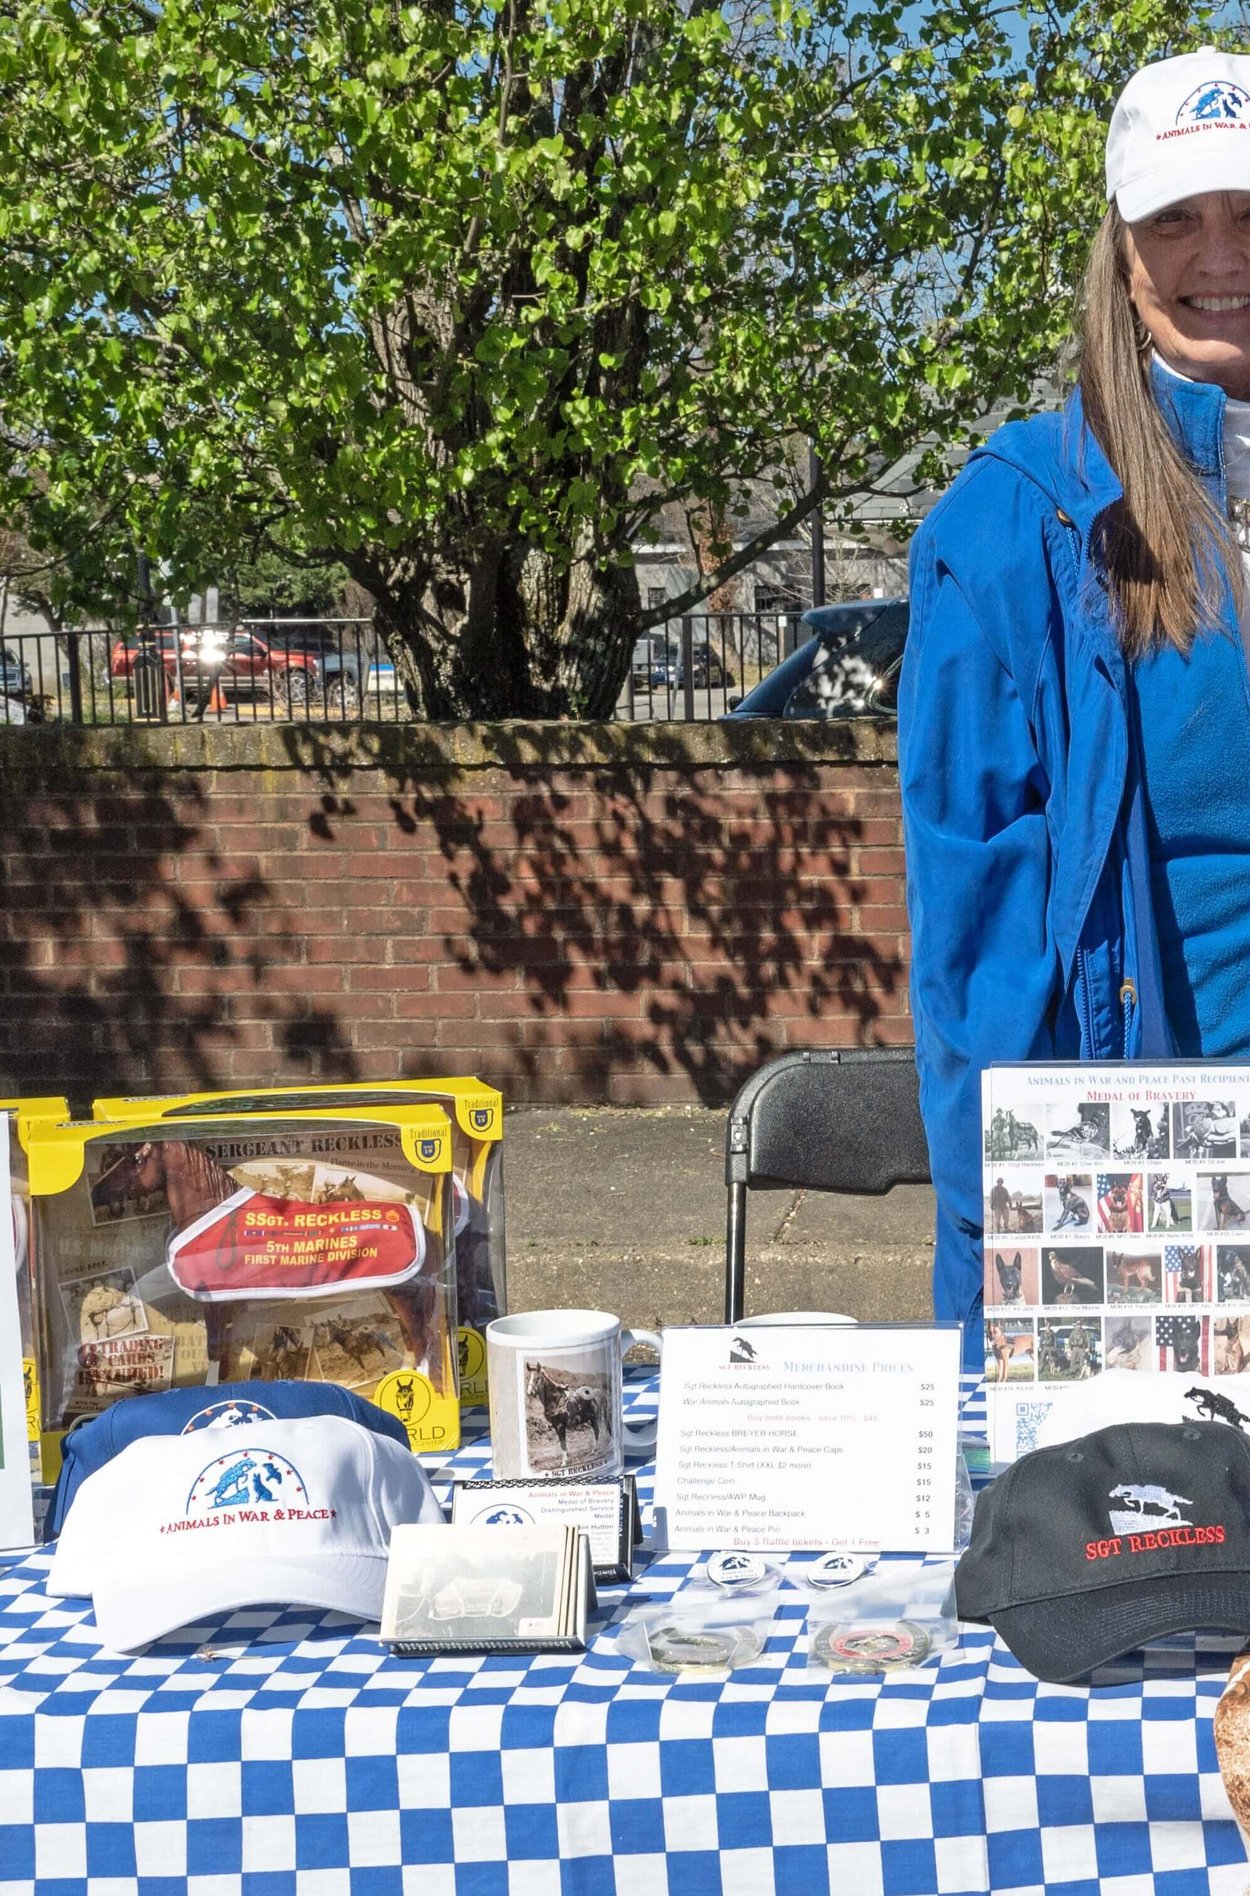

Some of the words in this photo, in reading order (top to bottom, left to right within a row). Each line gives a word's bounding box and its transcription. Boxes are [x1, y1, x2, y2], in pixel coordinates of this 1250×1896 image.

[1162, 125, 1200, 140] ANIMALS
[1239, 122, 1247, 130] &
[1026, 1076, 1070, 1086] ANIMALS
[1088, 1075, 1111, 1084] WAR
[1114, 1076, 1135, 1084] AND
[1138, 1074, 1168, 1084] PEACE
[1173, 1074, 1196, 1084] PAST
[1087, 1091, 1124, 1102] MEDAL
[1146, 1091, 1196, 1101] BRAVERY
[464, 1098, 498, 1108] Traditional
[410, 1128, 447, 1138] Traditional
[205, 1140, 304, 1159] SERGEANT
[311, 1133, 401, 1153] RECKLESS
[295, 1210, 382, 1227] RECKLESS
[266, 1240, 289, 1252] 5TH
[294, 1236, 358, 1252] MARINES
[244, 1254, 276, 1265] FIRST
[280, 1252, 324, 1265] MARINE
[328, 1248, 378, 1262] DIVISION
[101, 1338, 163, 1354] TRADING
[108, 1352, 156, 1366] CARDS
[784, 1361, 865, 1372] MERCHANDISE
[873, 1362, 914, 1372] PRICES
[734, 1382, 782, 1391] Autographed
[784, 1382, 823, 1390] Hardcover
[825, 1382, 844, 1390] Book
[920, 1383, 935, 1391] $25
[732, 1398, 778, 1407] Autographed
[781, 1398, 800, 1406] Book
[920, 1399, 934, 1407] $25
[680, 1430, 693, 1438] Sgt
[918, 1430, 932, 1438] $50
[680, 1446, 692, 1454] Sgt
[824, 1446, 844, 1454] Caps
[918, 1446, 932, 1454] $20
[918, 1462, 932, 1470] $15
[677, 1476, 716, 1486] Challenge
[718, 1476, 735, 1484] Coin
[916, 1478, 932, 1486] $15
[749, 1493, 766, 1502] Mug
[916, 1494, 930, 1502] $12
[675, 1509, 706, 1517] Animals
[717, 1509, 732, 1517] War
[742, 1509, 766, 1517] Peace
[769, 1509, 806, 1518] Backpack
[166, 1516, 220, 1534] ANIMALS
[224, 1514, 236, 1525] IN
[240, 1510, 268, 1522] WAR
[274, 1510, 286, 1520] &
[288, 1508, 329, 1520] PEACE
[716, 1525, 730, 1533] War
[734, 1538, 750, 1546] Buy
[763, 1538, 790, 1546] Raffle
[792, 1538, 823, 1546] tickets
[859, 1538, 880, 1546] Free
[1086, 1537, 1122, 1560] SGT
[1129, 1526, 1225, 1553] RECKLESS
